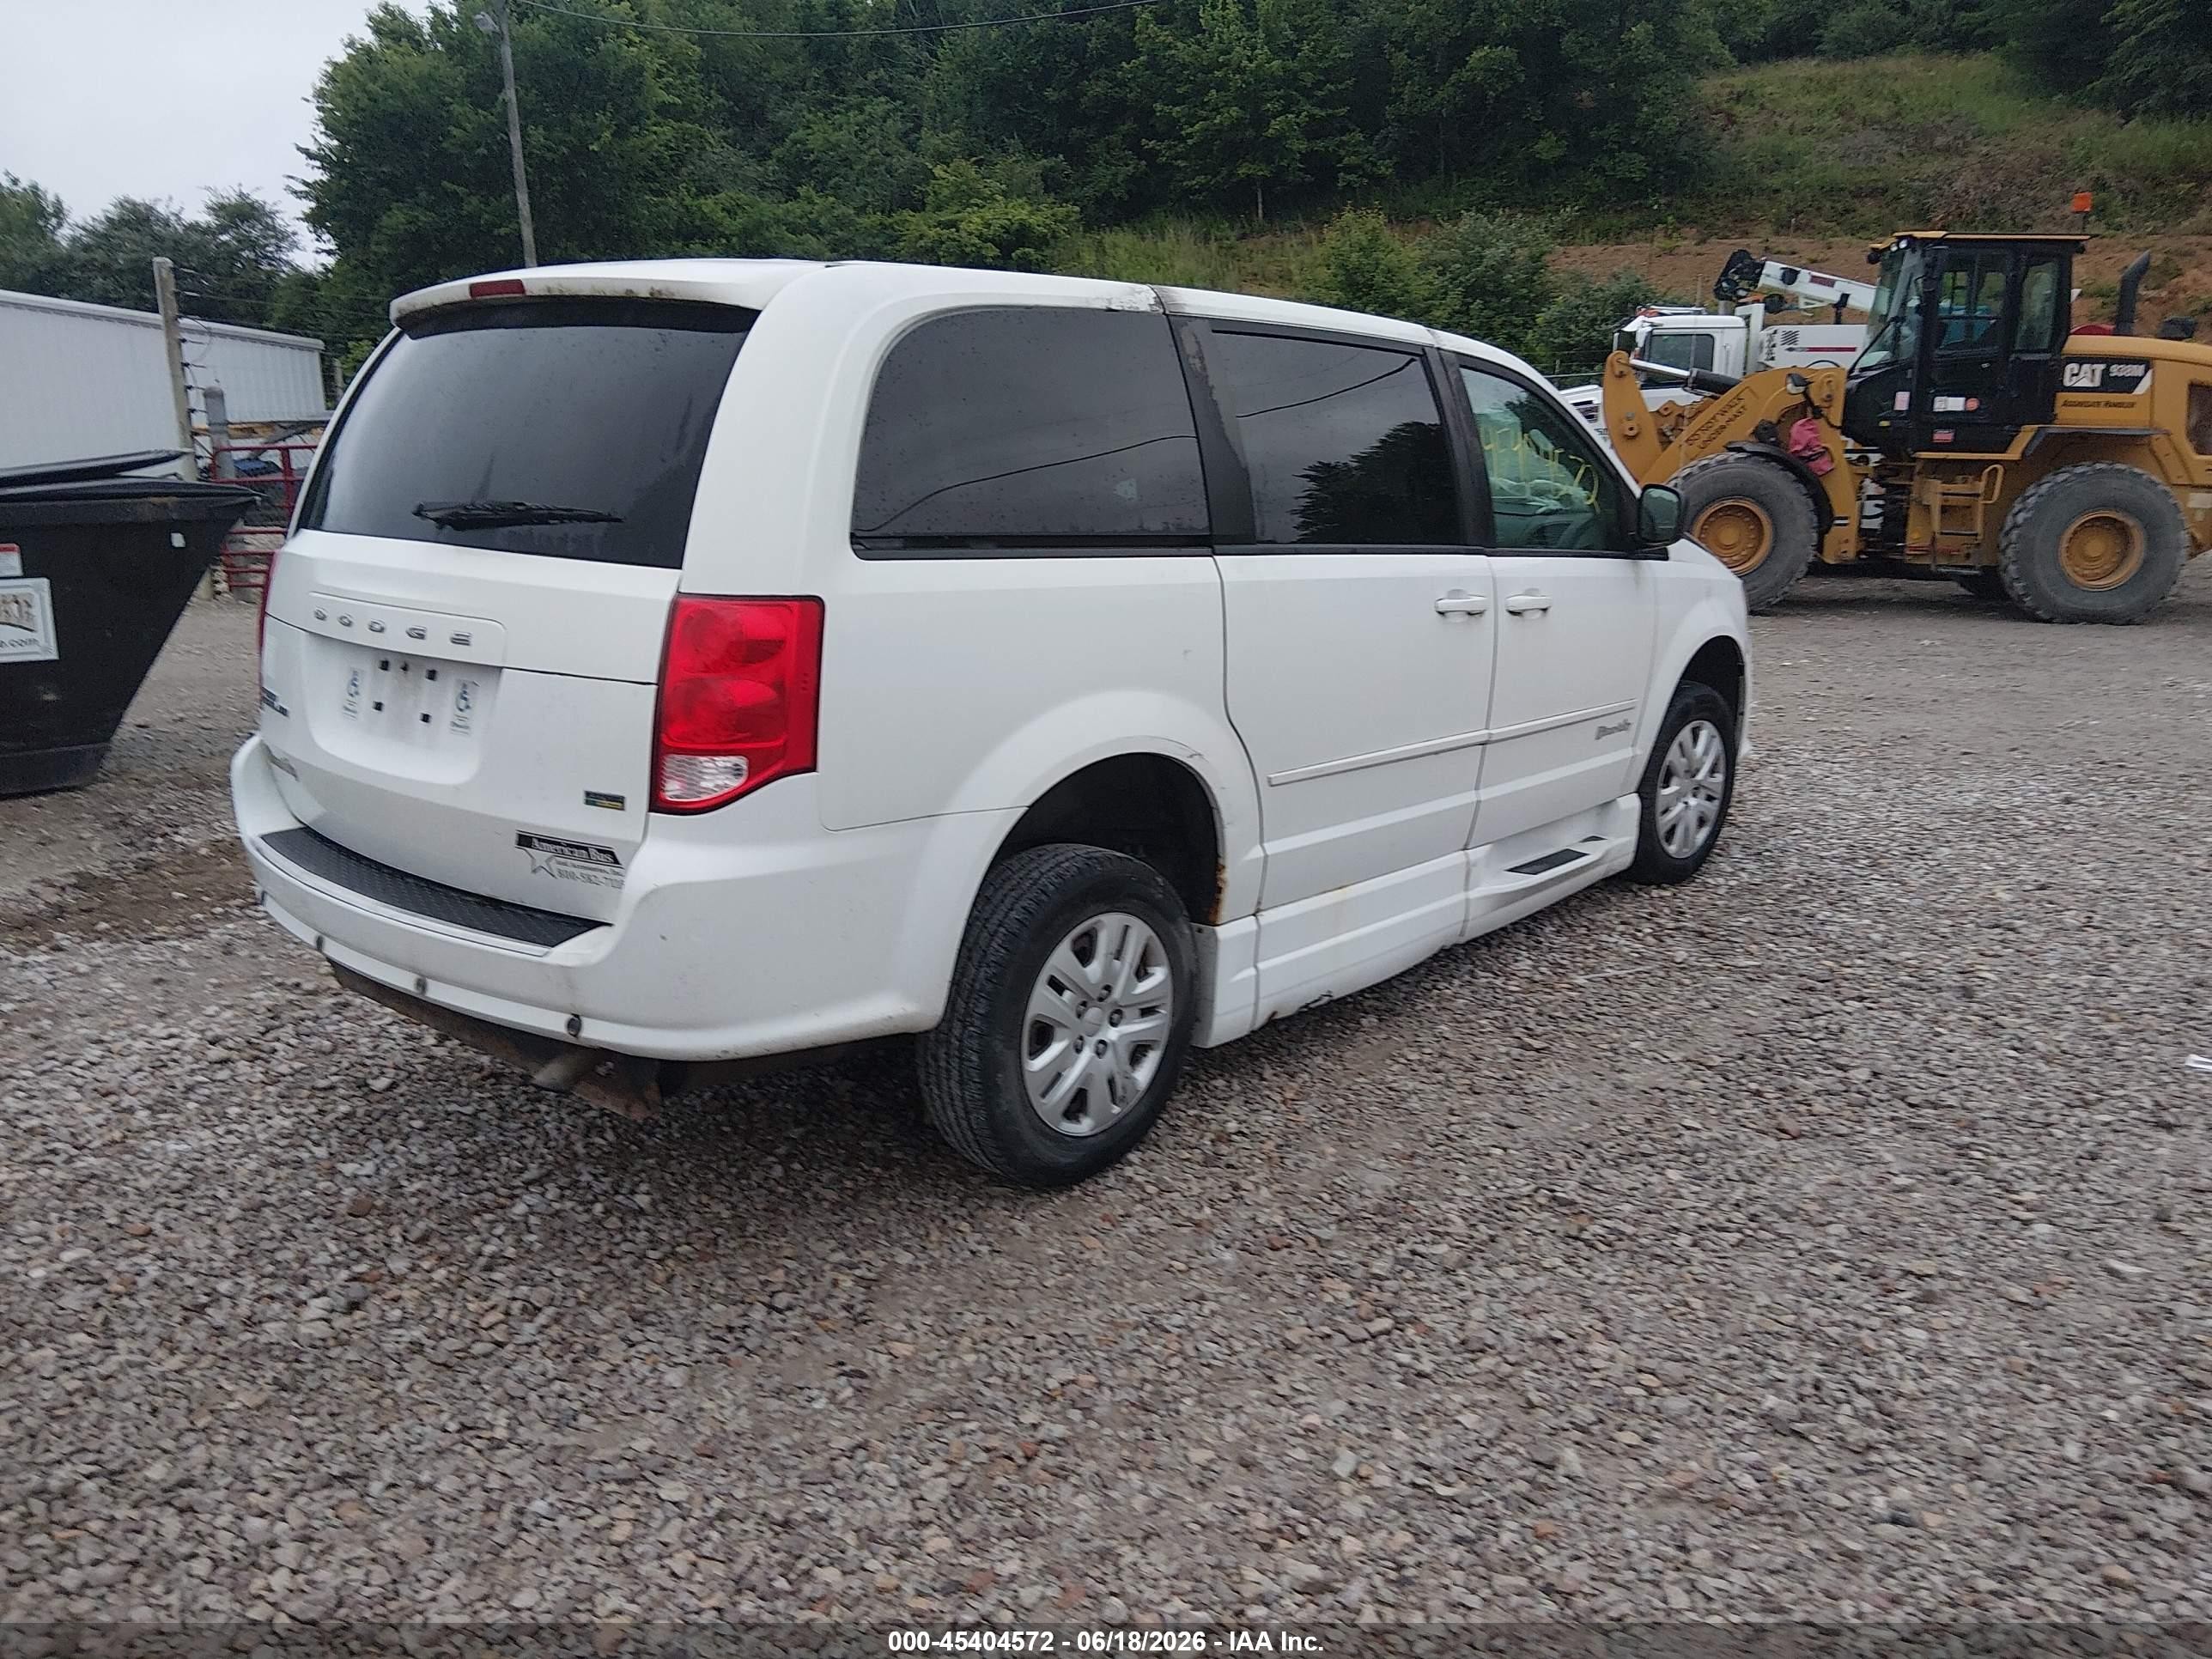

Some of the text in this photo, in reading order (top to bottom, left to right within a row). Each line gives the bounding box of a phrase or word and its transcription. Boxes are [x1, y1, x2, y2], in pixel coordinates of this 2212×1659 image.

[2063, 362, 2106, 386] CAT
[313, 605, 472, 647] DODGE
[532, 837, 617, 864] American Bus
